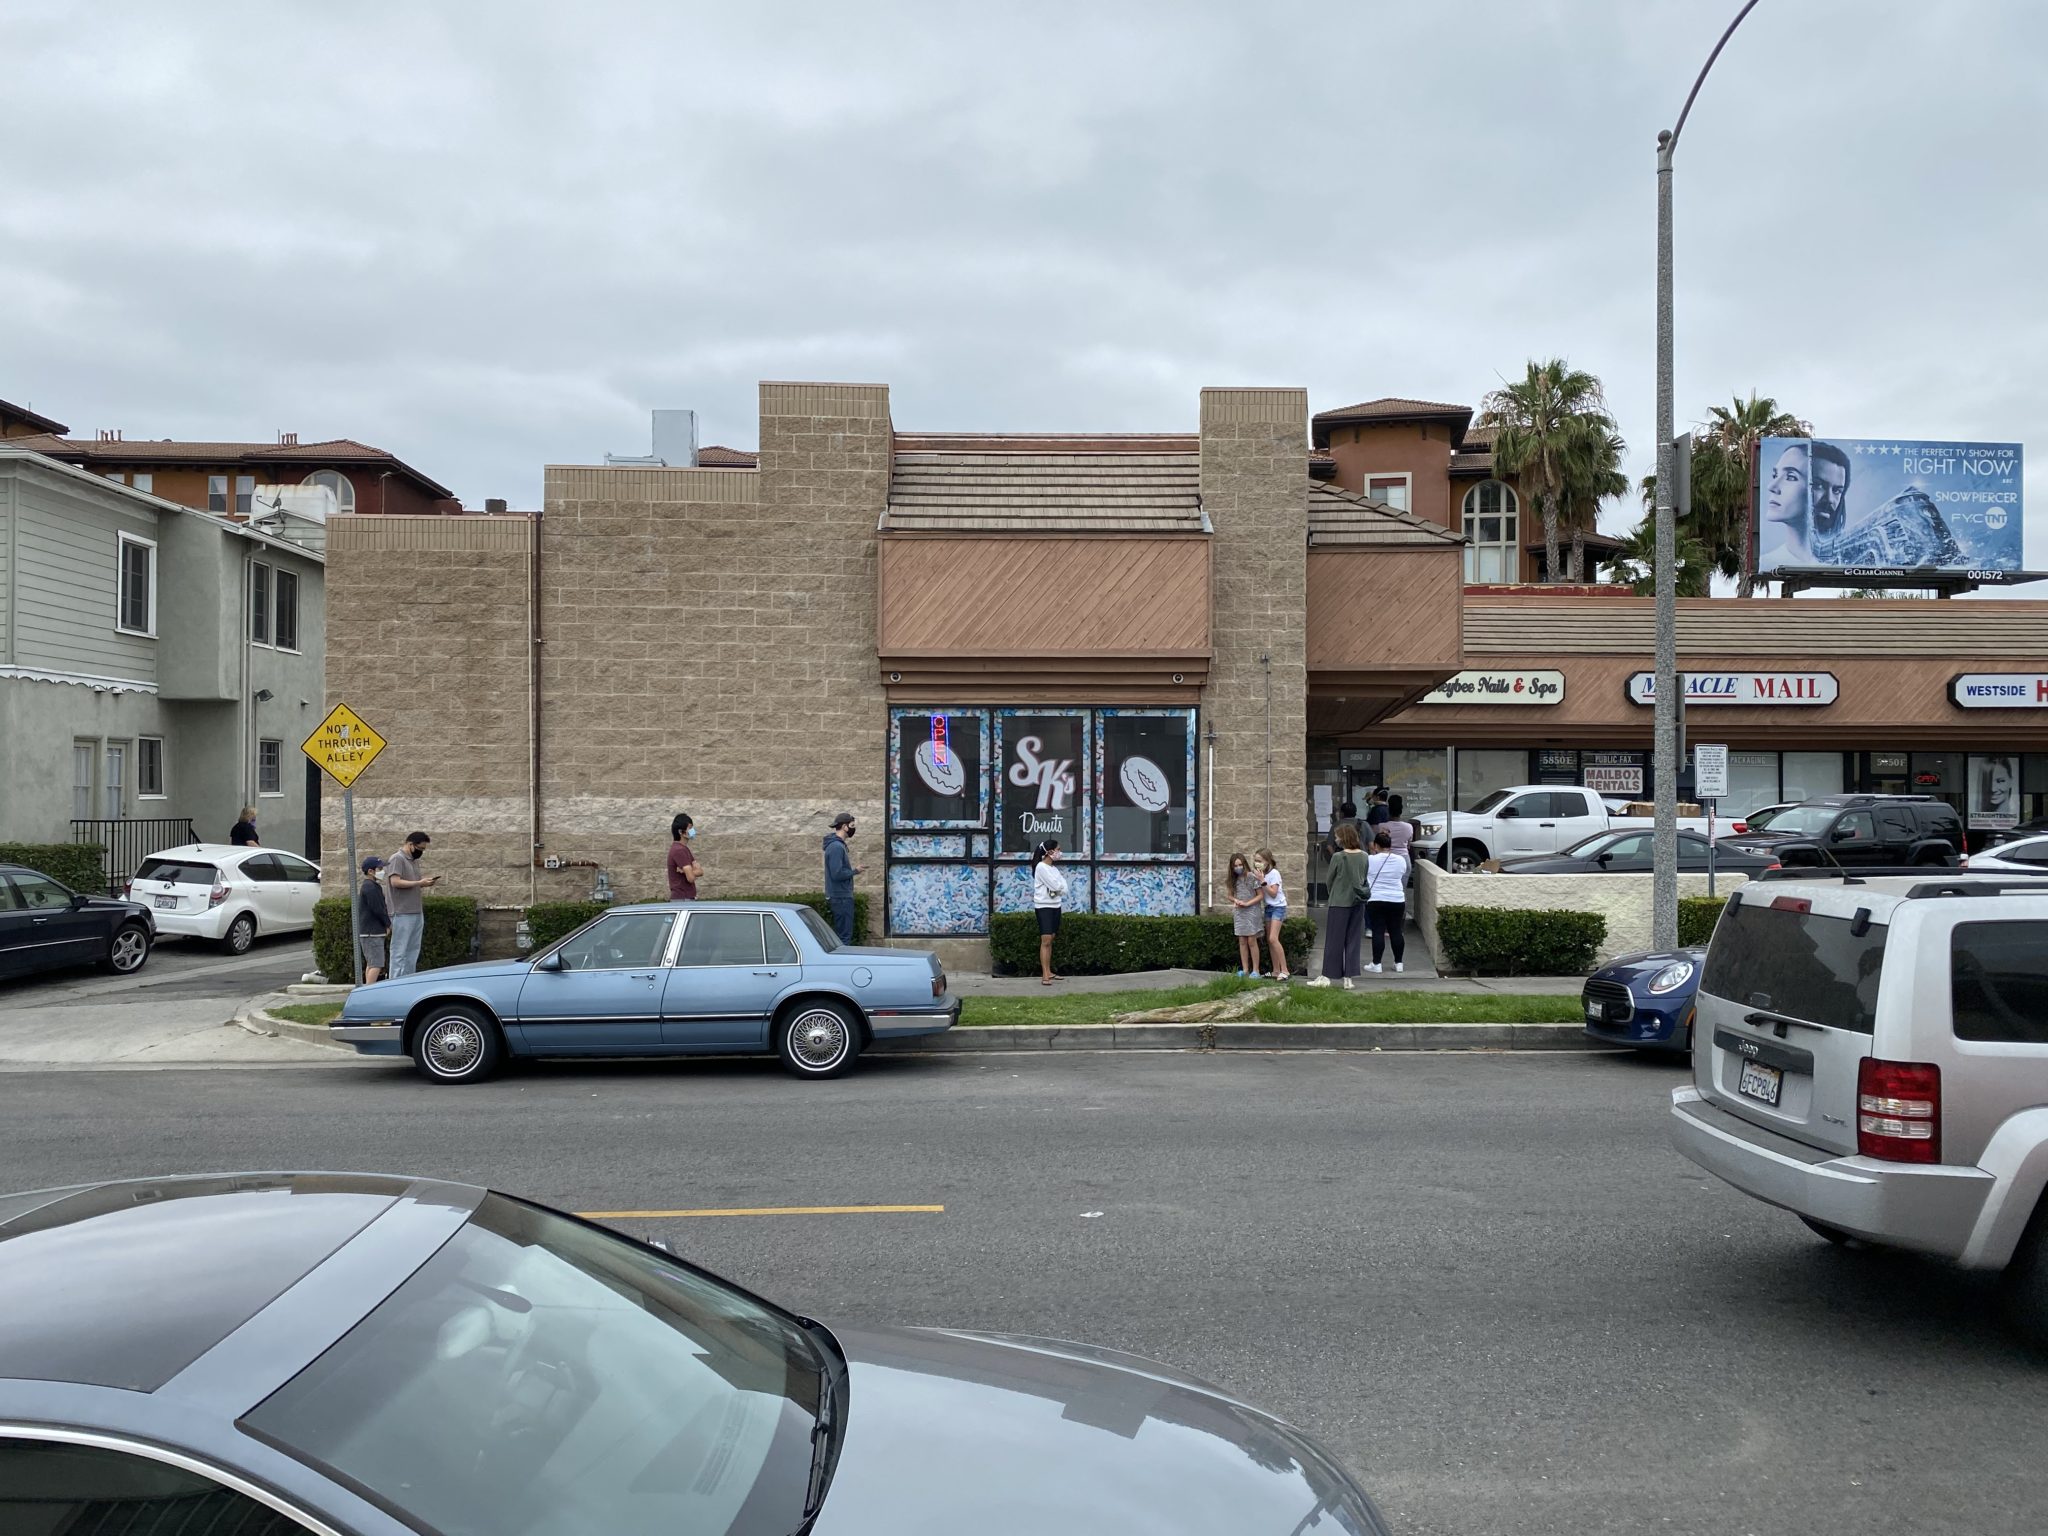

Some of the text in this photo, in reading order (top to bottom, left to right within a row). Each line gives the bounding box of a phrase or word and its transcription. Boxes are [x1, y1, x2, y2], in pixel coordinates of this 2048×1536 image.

[1921, 448, 1953, 456] PERFECT
[1956, 448, 1966, 456] TV
[1968, 449, 1995, 457] SHOW
[1997, 449, 2014, 457] FOR
[1903, 458, 1956, 474] RIGHT
[1935, 491, 2017, 503] SNOWPIERCER
[1985, 513, 2008, 524] TNT
[1968, 571, 2002, 580] 001572
[1477, 676, 1510, 694] Nails
[1513, 677, 1525, 693] &
[1528, 677, 1557, 698] Spa
[1641, 677, 1821, 698] MACLE MAIL
[1966, 685, 2026, 696] WESTSIDE
[353, 723, 360, 733] A
[318, 738, 370, 748] THROUGH
[933, 715, 946, 764] OPEN
[327, 752, 364, 762] ALLEY
[1595, 754, 1632, 764] PUBLIC FAX
[1730, 756, 1766, 765] PACKAGING
[1586, 769, 1640, 780] MAILBOX
[1590, 780, 1640, 791] RENTALS
[1019, 812, 1064, 833] Donuts
[1738, 1040, 1759, 1055] Jeep
[1741, 1074, 1776, 1100] 6FCP846
